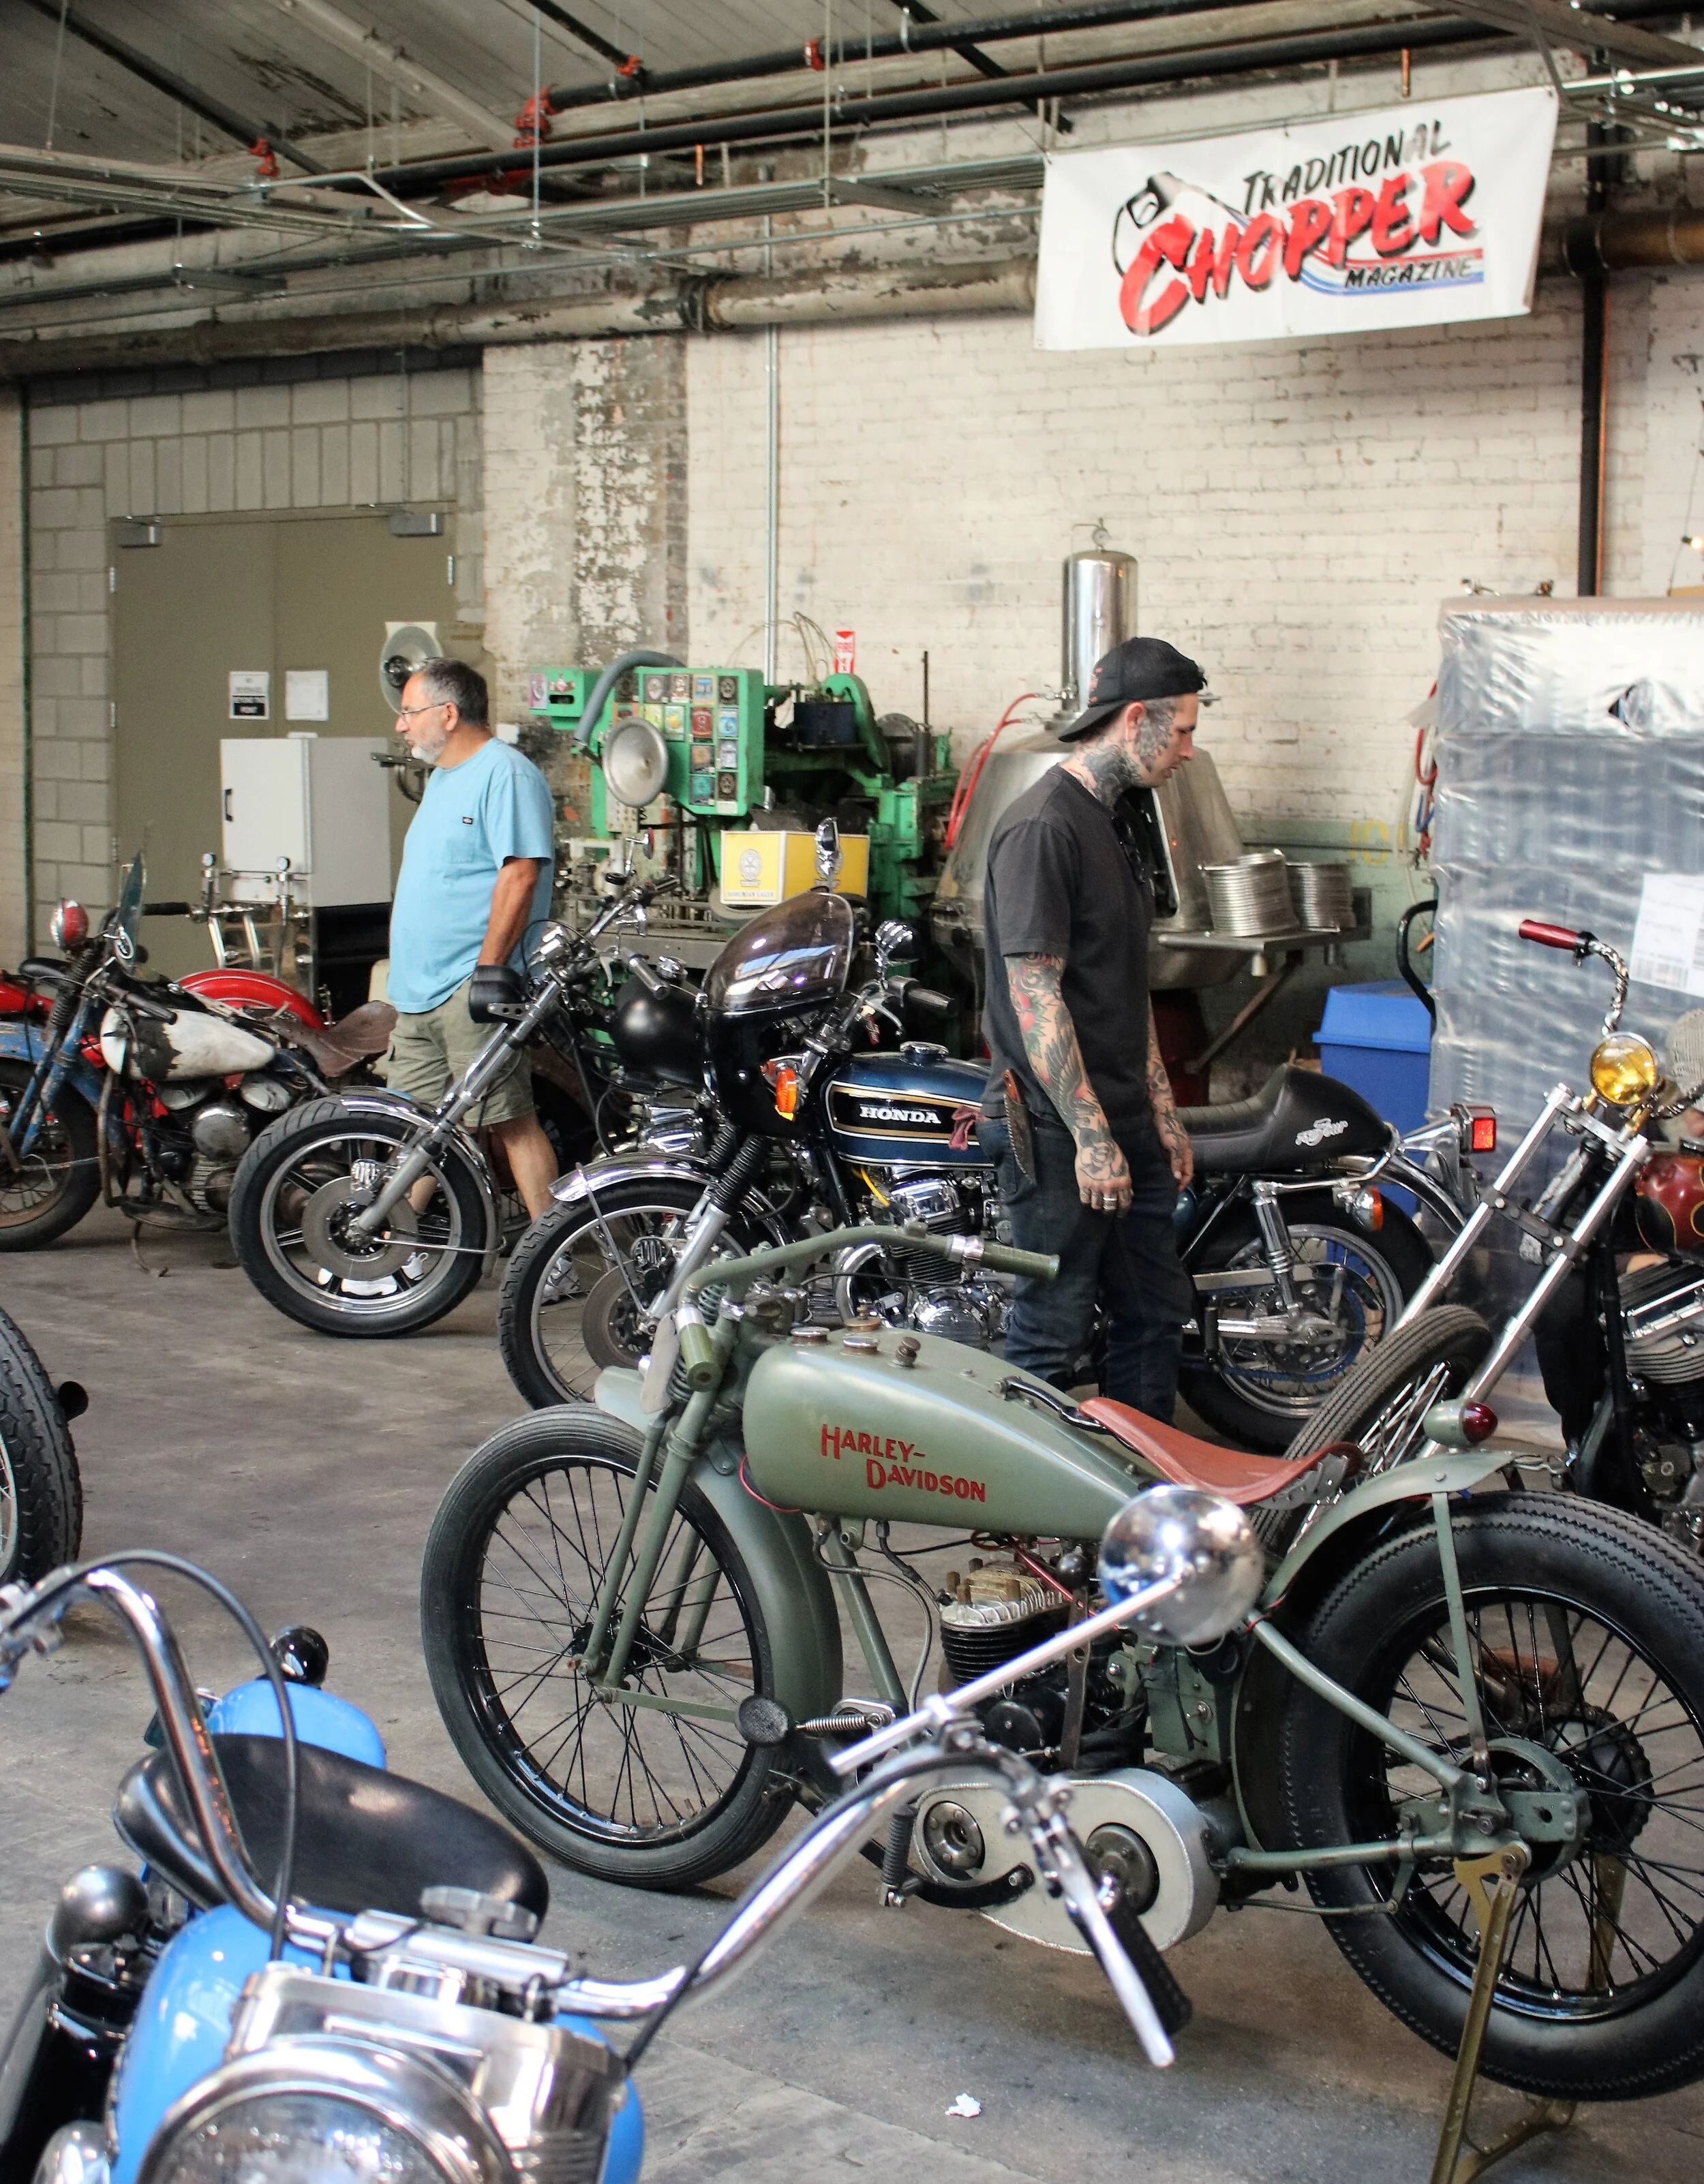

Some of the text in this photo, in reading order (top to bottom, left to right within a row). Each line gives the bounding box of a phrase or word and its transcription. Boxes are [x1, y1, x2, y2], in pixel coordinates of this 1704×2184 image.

[1243, 119, 1450, 212] TRADITIONAL
[1119, 161, 1479, 336] CHOPPER
[1345, 258, 1474, 289] MAGAZINE
[859, 1105, 942, 1124] HONDA
[821, 1424, 926, 1462] HARLEY-
[866, 1458, 986, 1503] DAVIDSON
